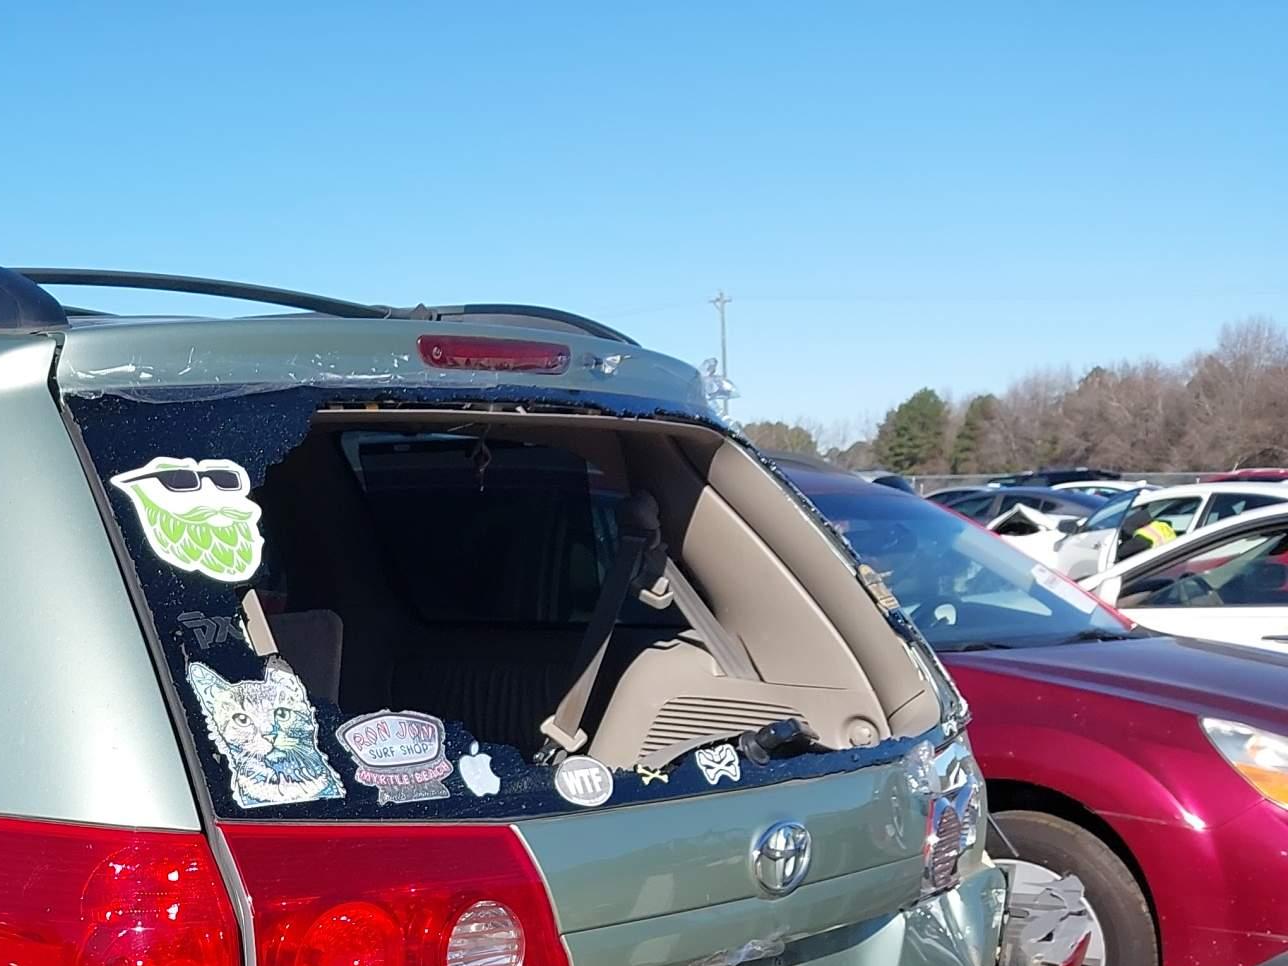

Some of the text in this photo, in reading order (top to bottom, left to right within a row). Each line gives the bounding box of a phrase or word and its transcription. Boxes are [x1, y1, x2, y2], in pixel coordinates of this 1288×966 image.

[353, 720, 391, 752] RON
[368, 742, 429, 760] SURF SHOP
[358, 759, 450, 785] MYRTLE BEACH
[561, 767, 602, 795] WTF
